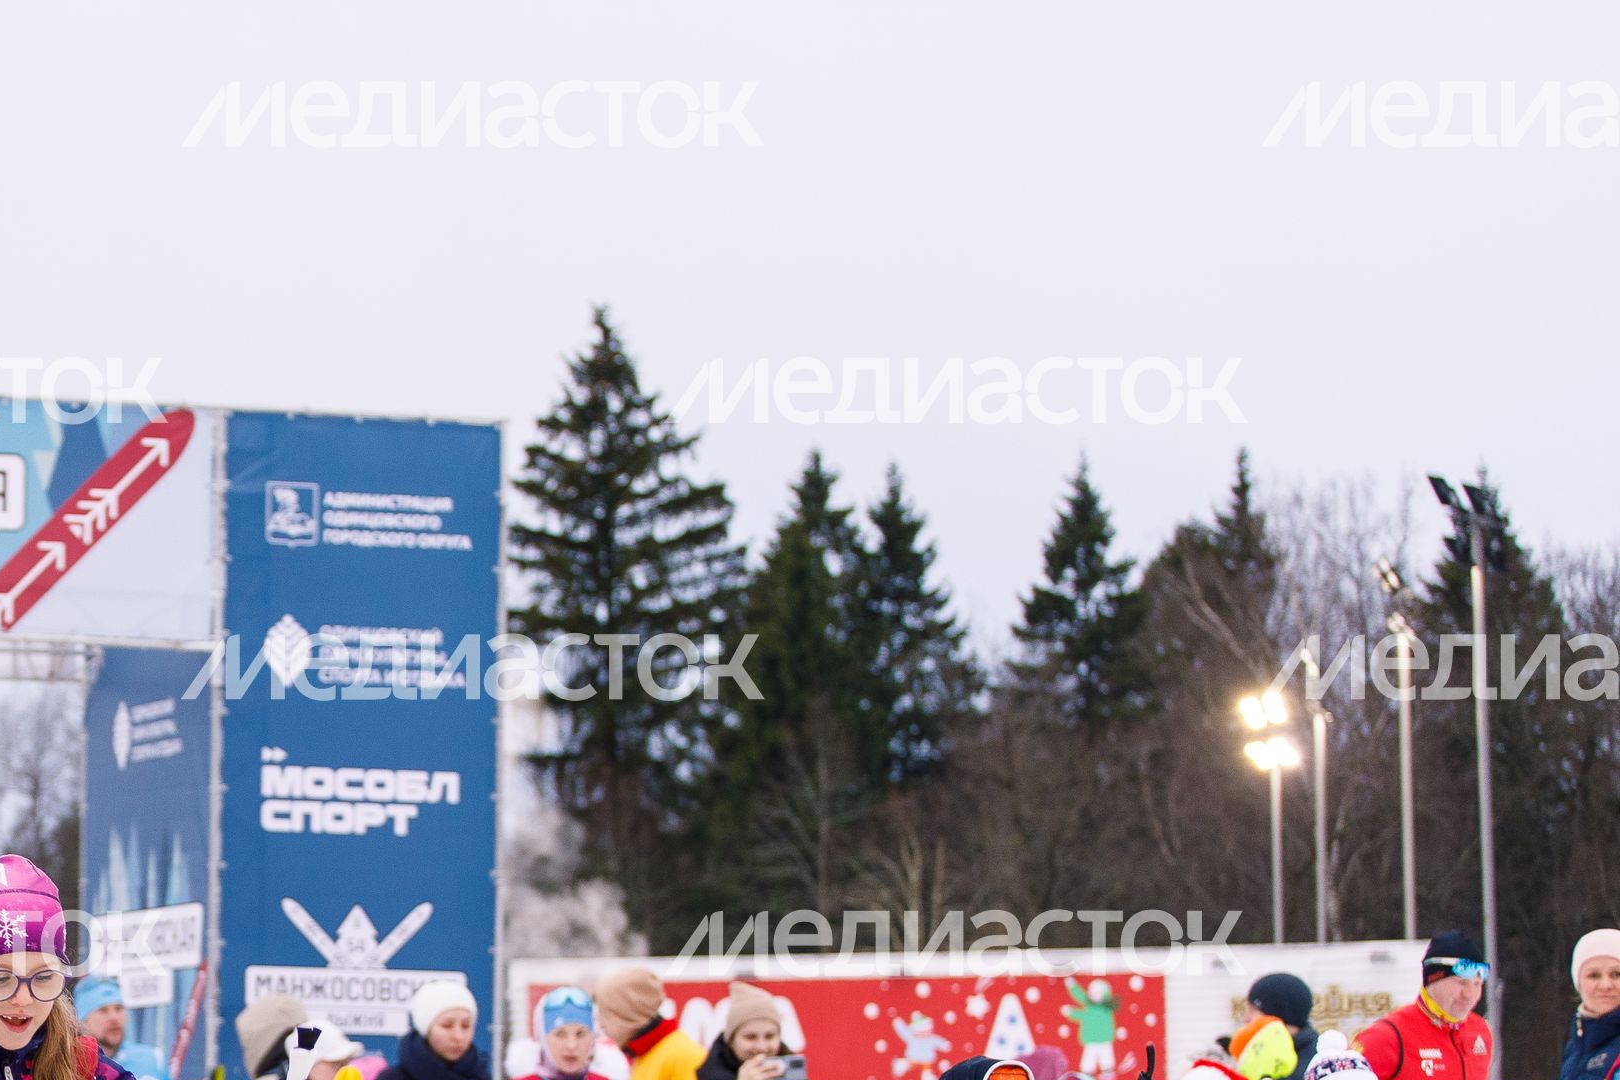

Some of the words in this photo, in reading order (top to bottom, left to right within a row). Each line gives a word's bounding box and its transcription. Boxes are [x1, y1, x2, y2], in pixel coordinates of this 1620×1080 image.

[260, 764, 461, 805] МОСОБЛ
[260, 800, 419, 837] СПОРТ
[254, 974, 458, 1002] МАНЖОСОВСК
